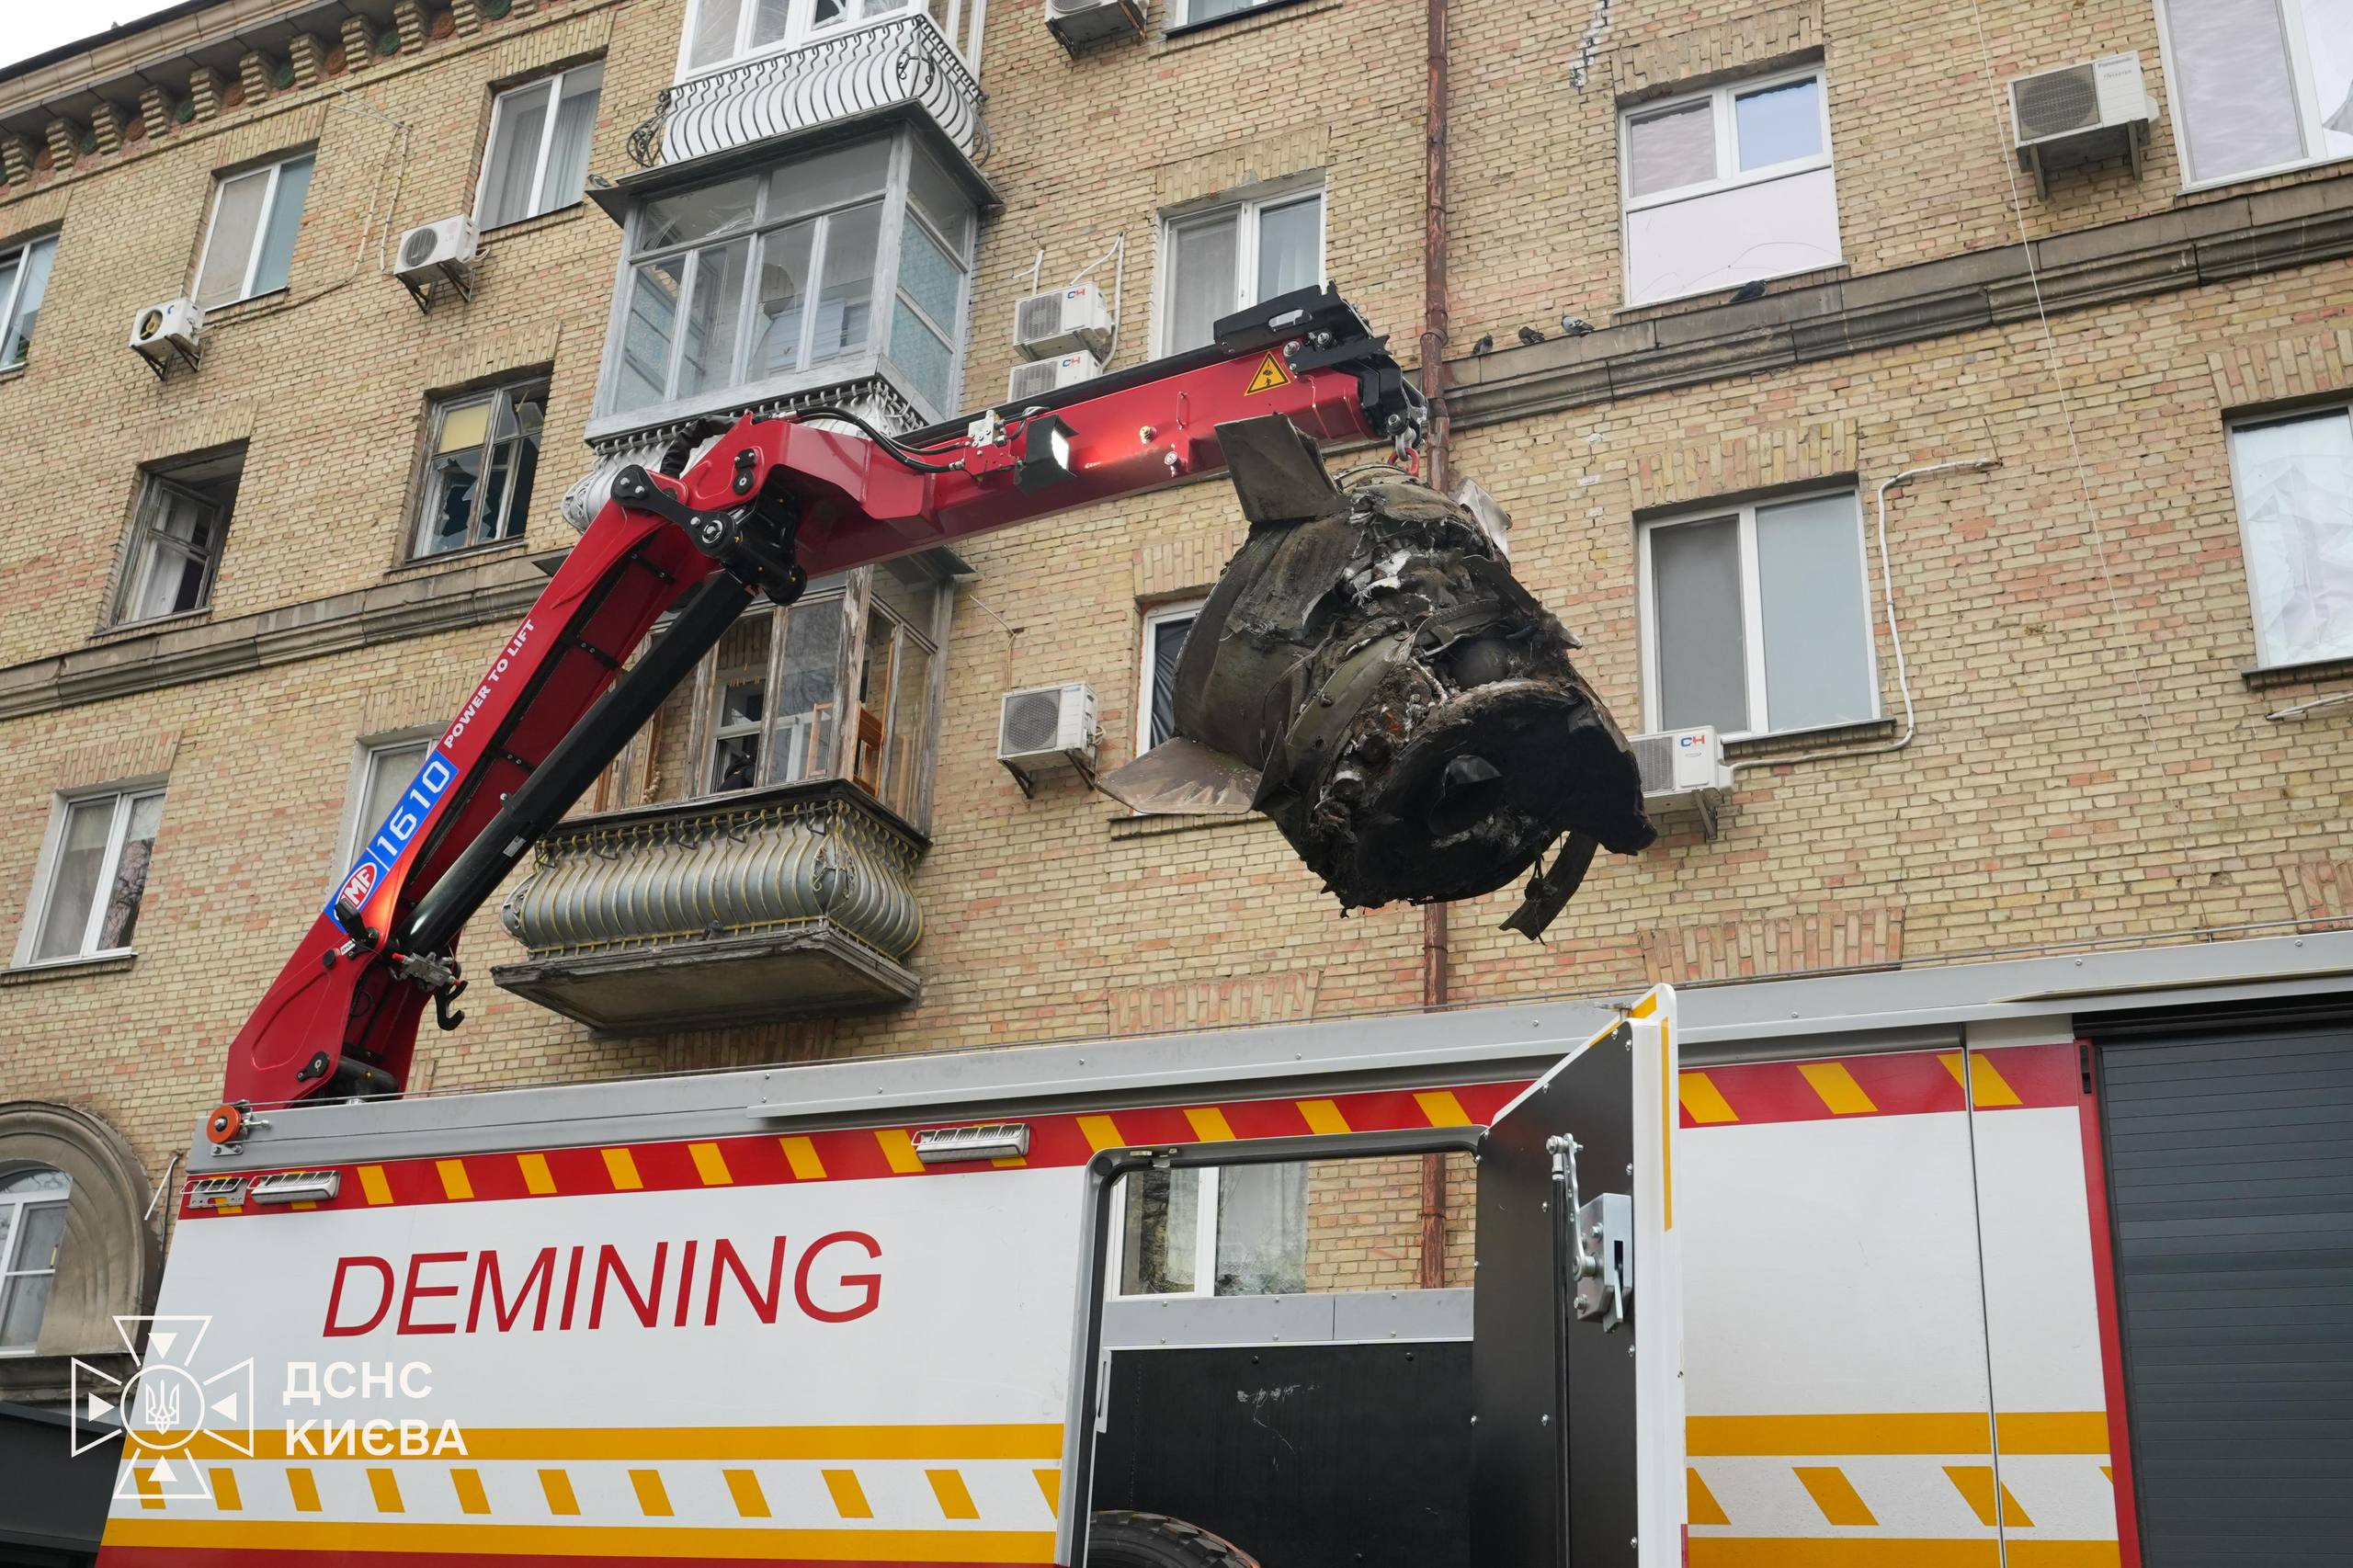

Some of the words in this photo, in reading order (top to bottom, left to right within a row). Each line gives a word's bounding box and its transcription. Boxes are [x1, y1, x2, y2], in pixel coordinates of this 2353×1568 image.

[1067, 289, 1086, 299] CH
[1063, 357, 1081, 368] CH
[444, 685, 492, 749] POWER
[487, 658, 509, 682] TO
[506, 619, 535, 656] LIFT
[1680, 734, 1705, 747] CH
[377, 760, 450, 857] 1610
[340, 869, 371, 905] MF
[322, 1230, 883, 1338] DEMINING
